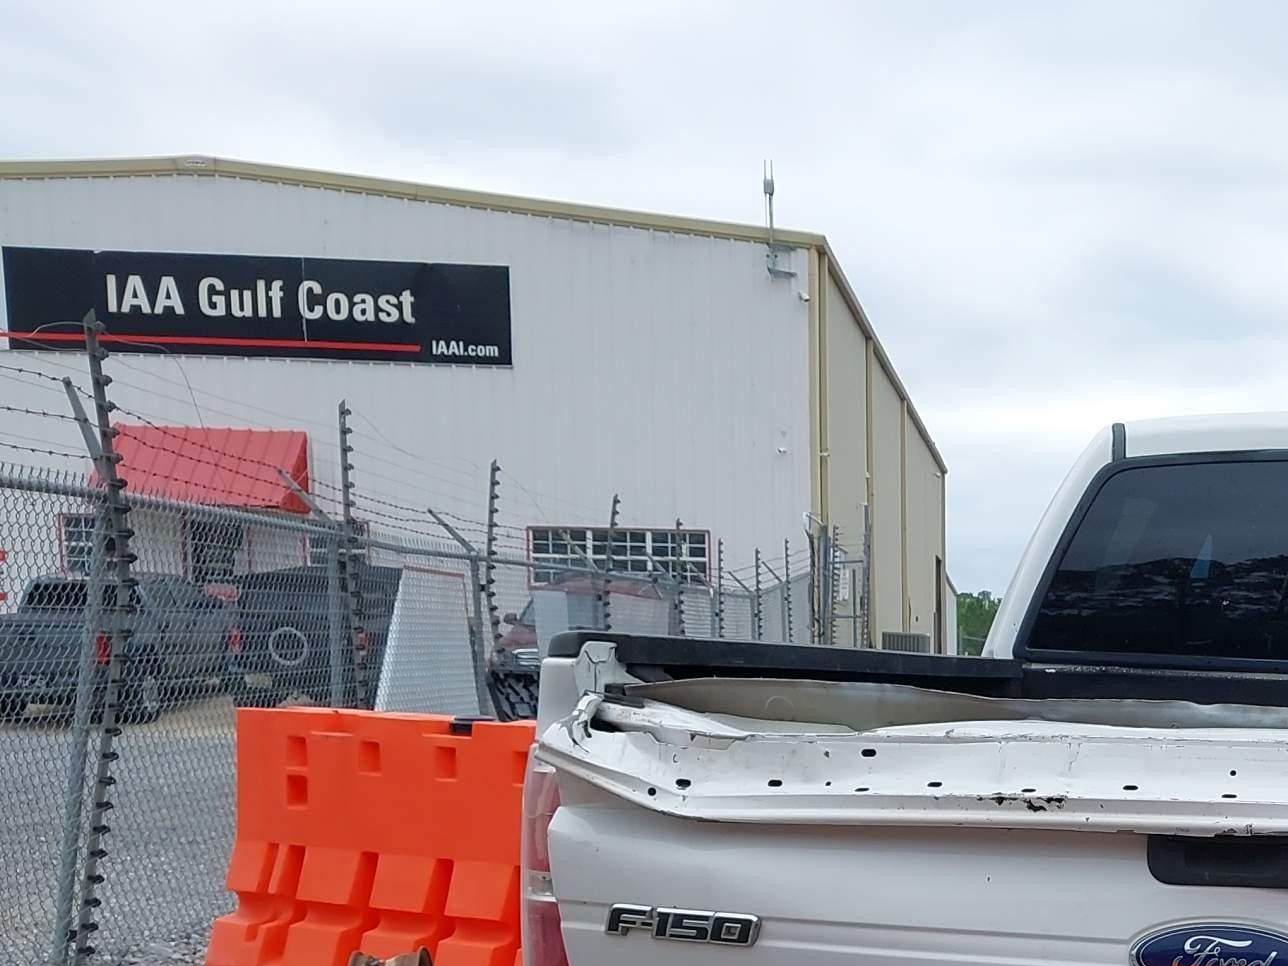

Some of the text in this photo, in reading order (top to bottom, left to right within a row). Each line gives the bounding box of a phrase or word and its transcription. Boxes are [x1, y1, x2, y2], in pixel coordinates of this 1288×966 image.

[106, 274, 416, 324] IAA Gulf Coast
[431, 339, 499, 357] IAAI.com
[606, 903, 761, 947] F-150
